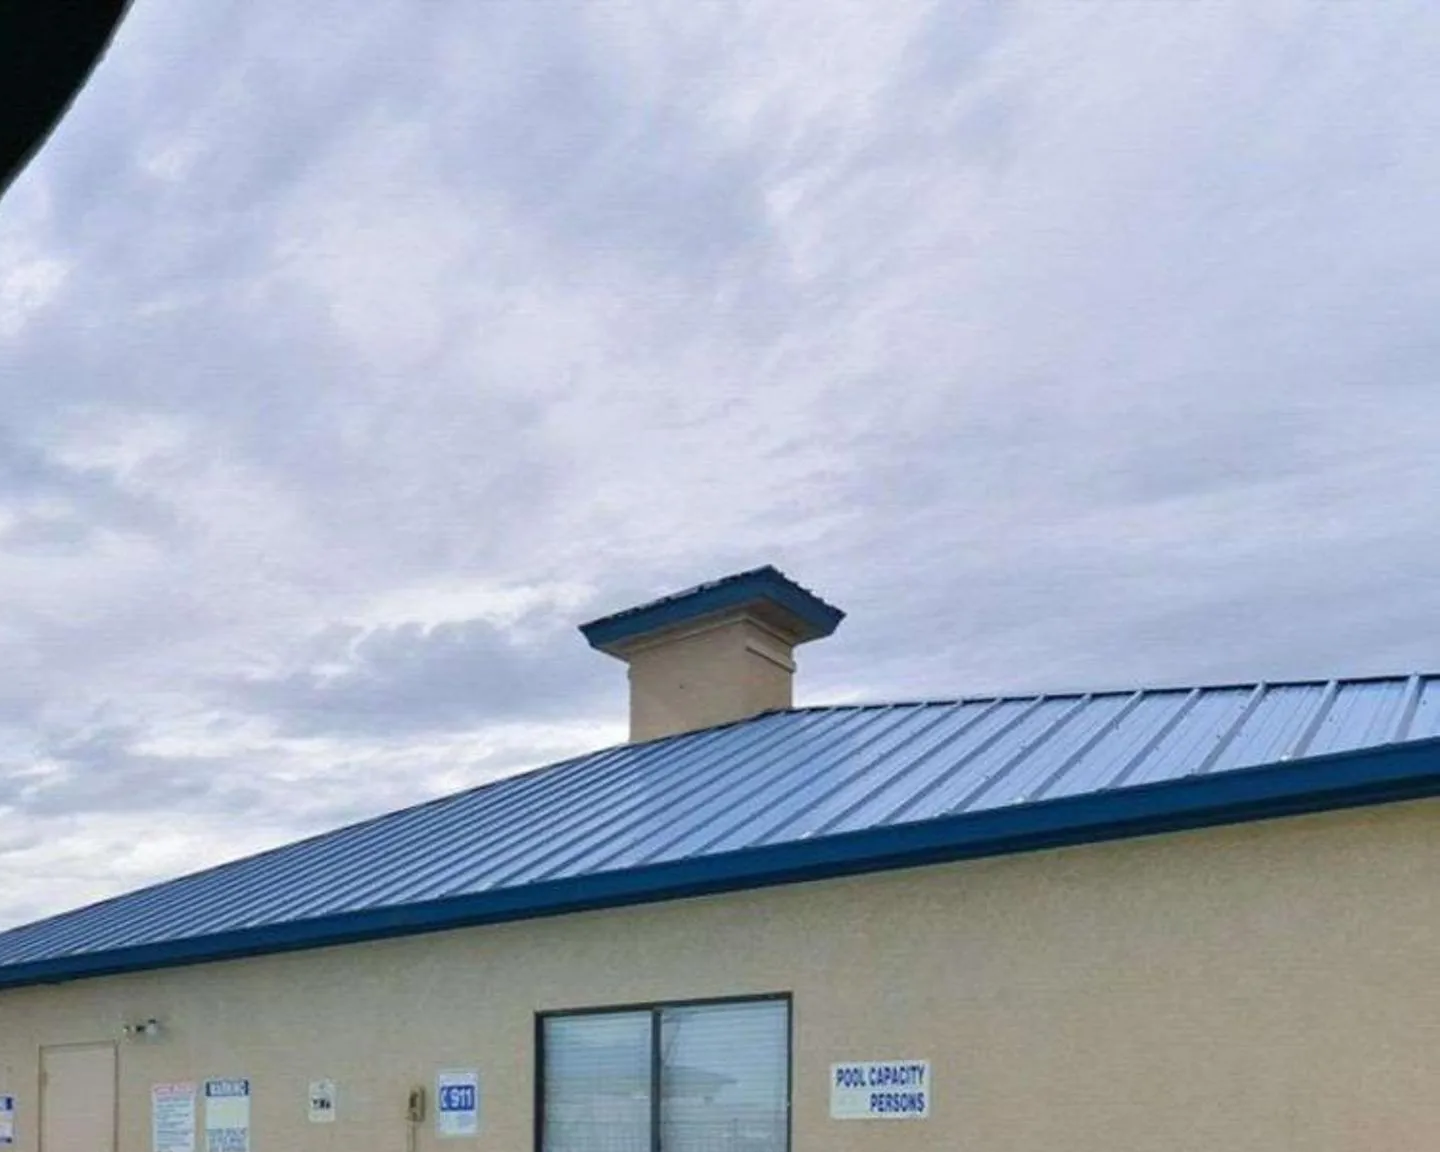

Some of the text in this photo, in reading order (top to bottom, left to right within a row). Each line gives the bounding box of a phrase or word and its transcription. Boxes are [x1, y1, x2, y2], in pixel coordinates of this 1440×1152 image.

[836, 1064, 925, 1087] POOL CAPACITY
[450, 1088, 471, 1108] 911
[870, 1092, 925, 1112] PERSONS
